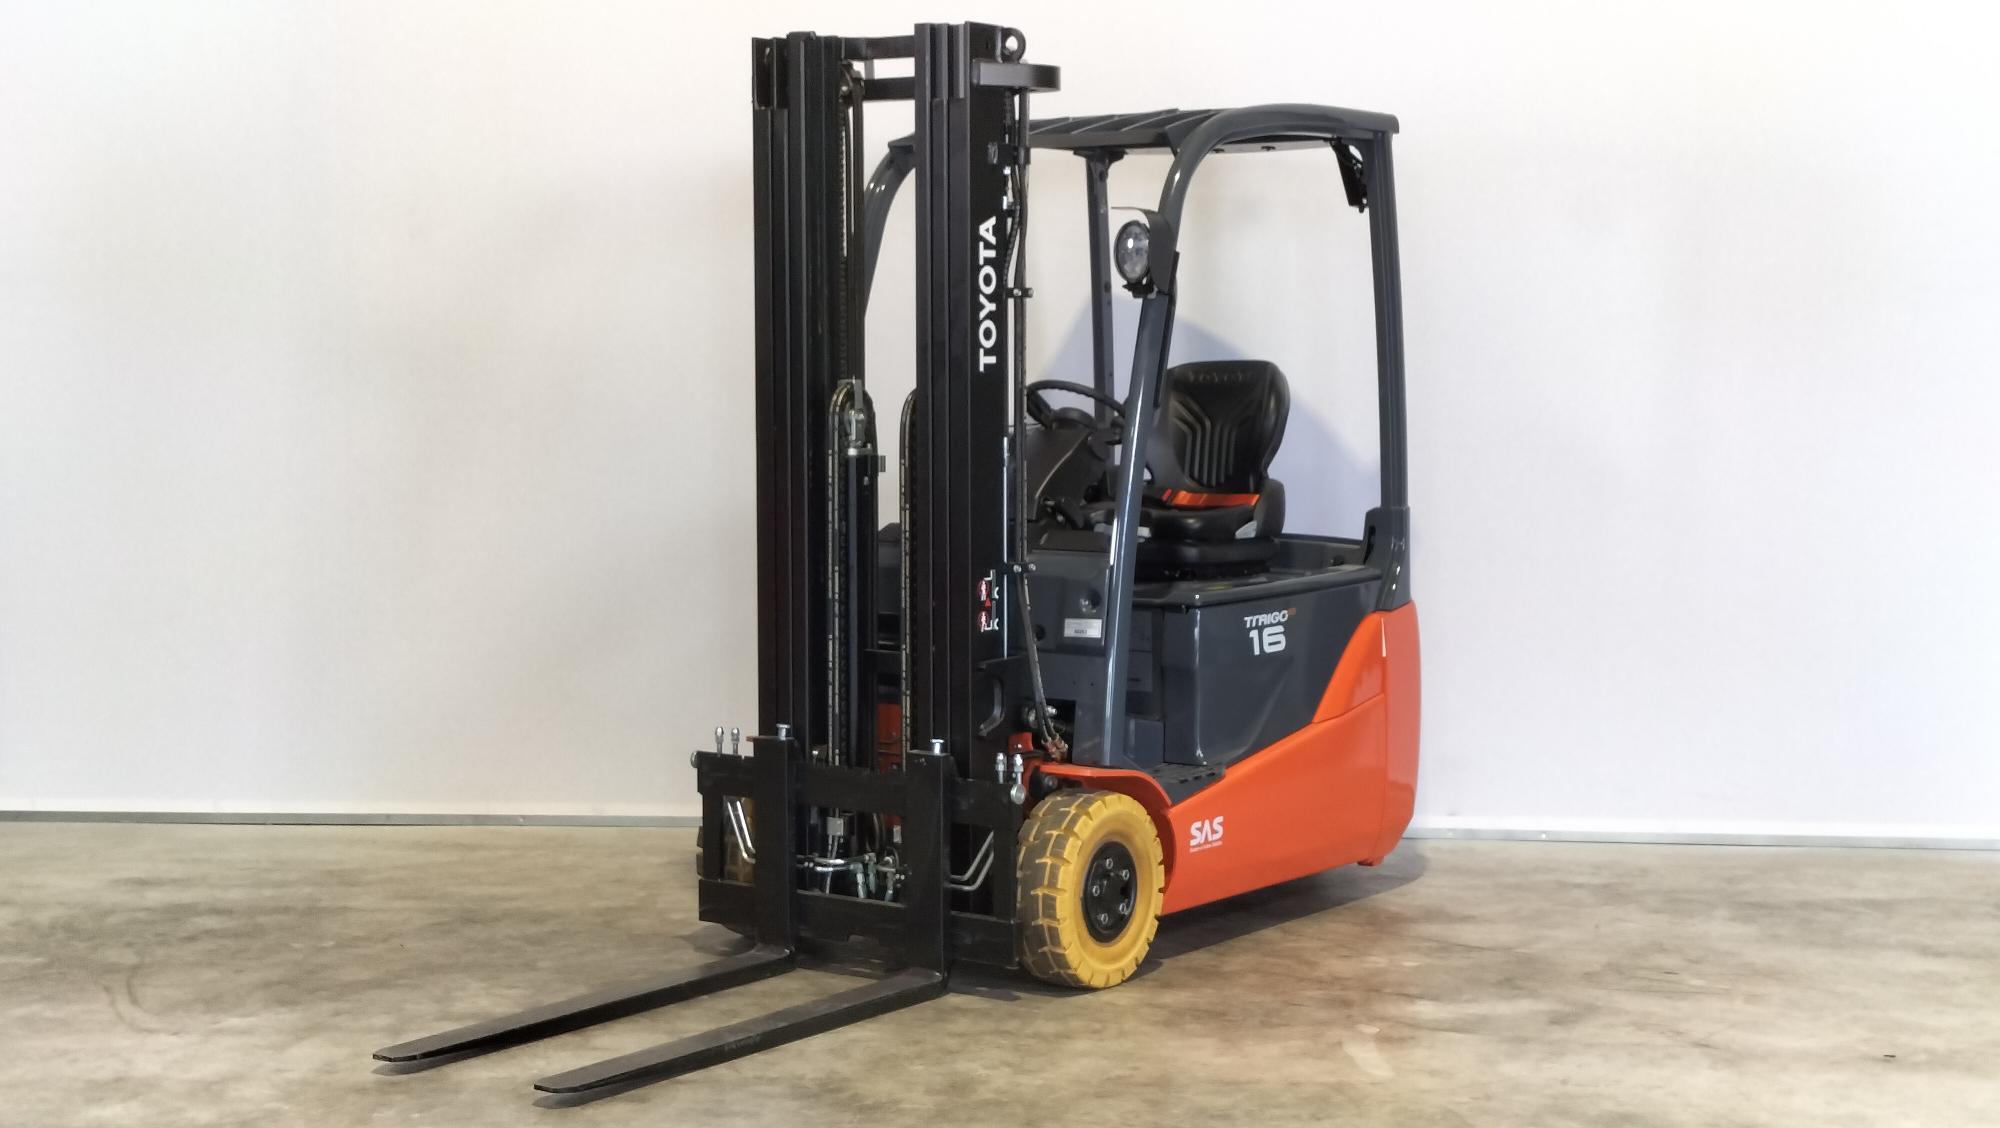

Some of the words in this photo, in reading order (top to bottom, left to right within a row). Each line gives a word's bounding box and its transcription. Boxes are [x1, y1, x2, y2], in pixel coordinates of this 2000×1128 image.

[979, 216, 997, 372] TOYOTA
[1249, 625, 1286, 655] 16
[1190, 816, 1223, 846] SAS
